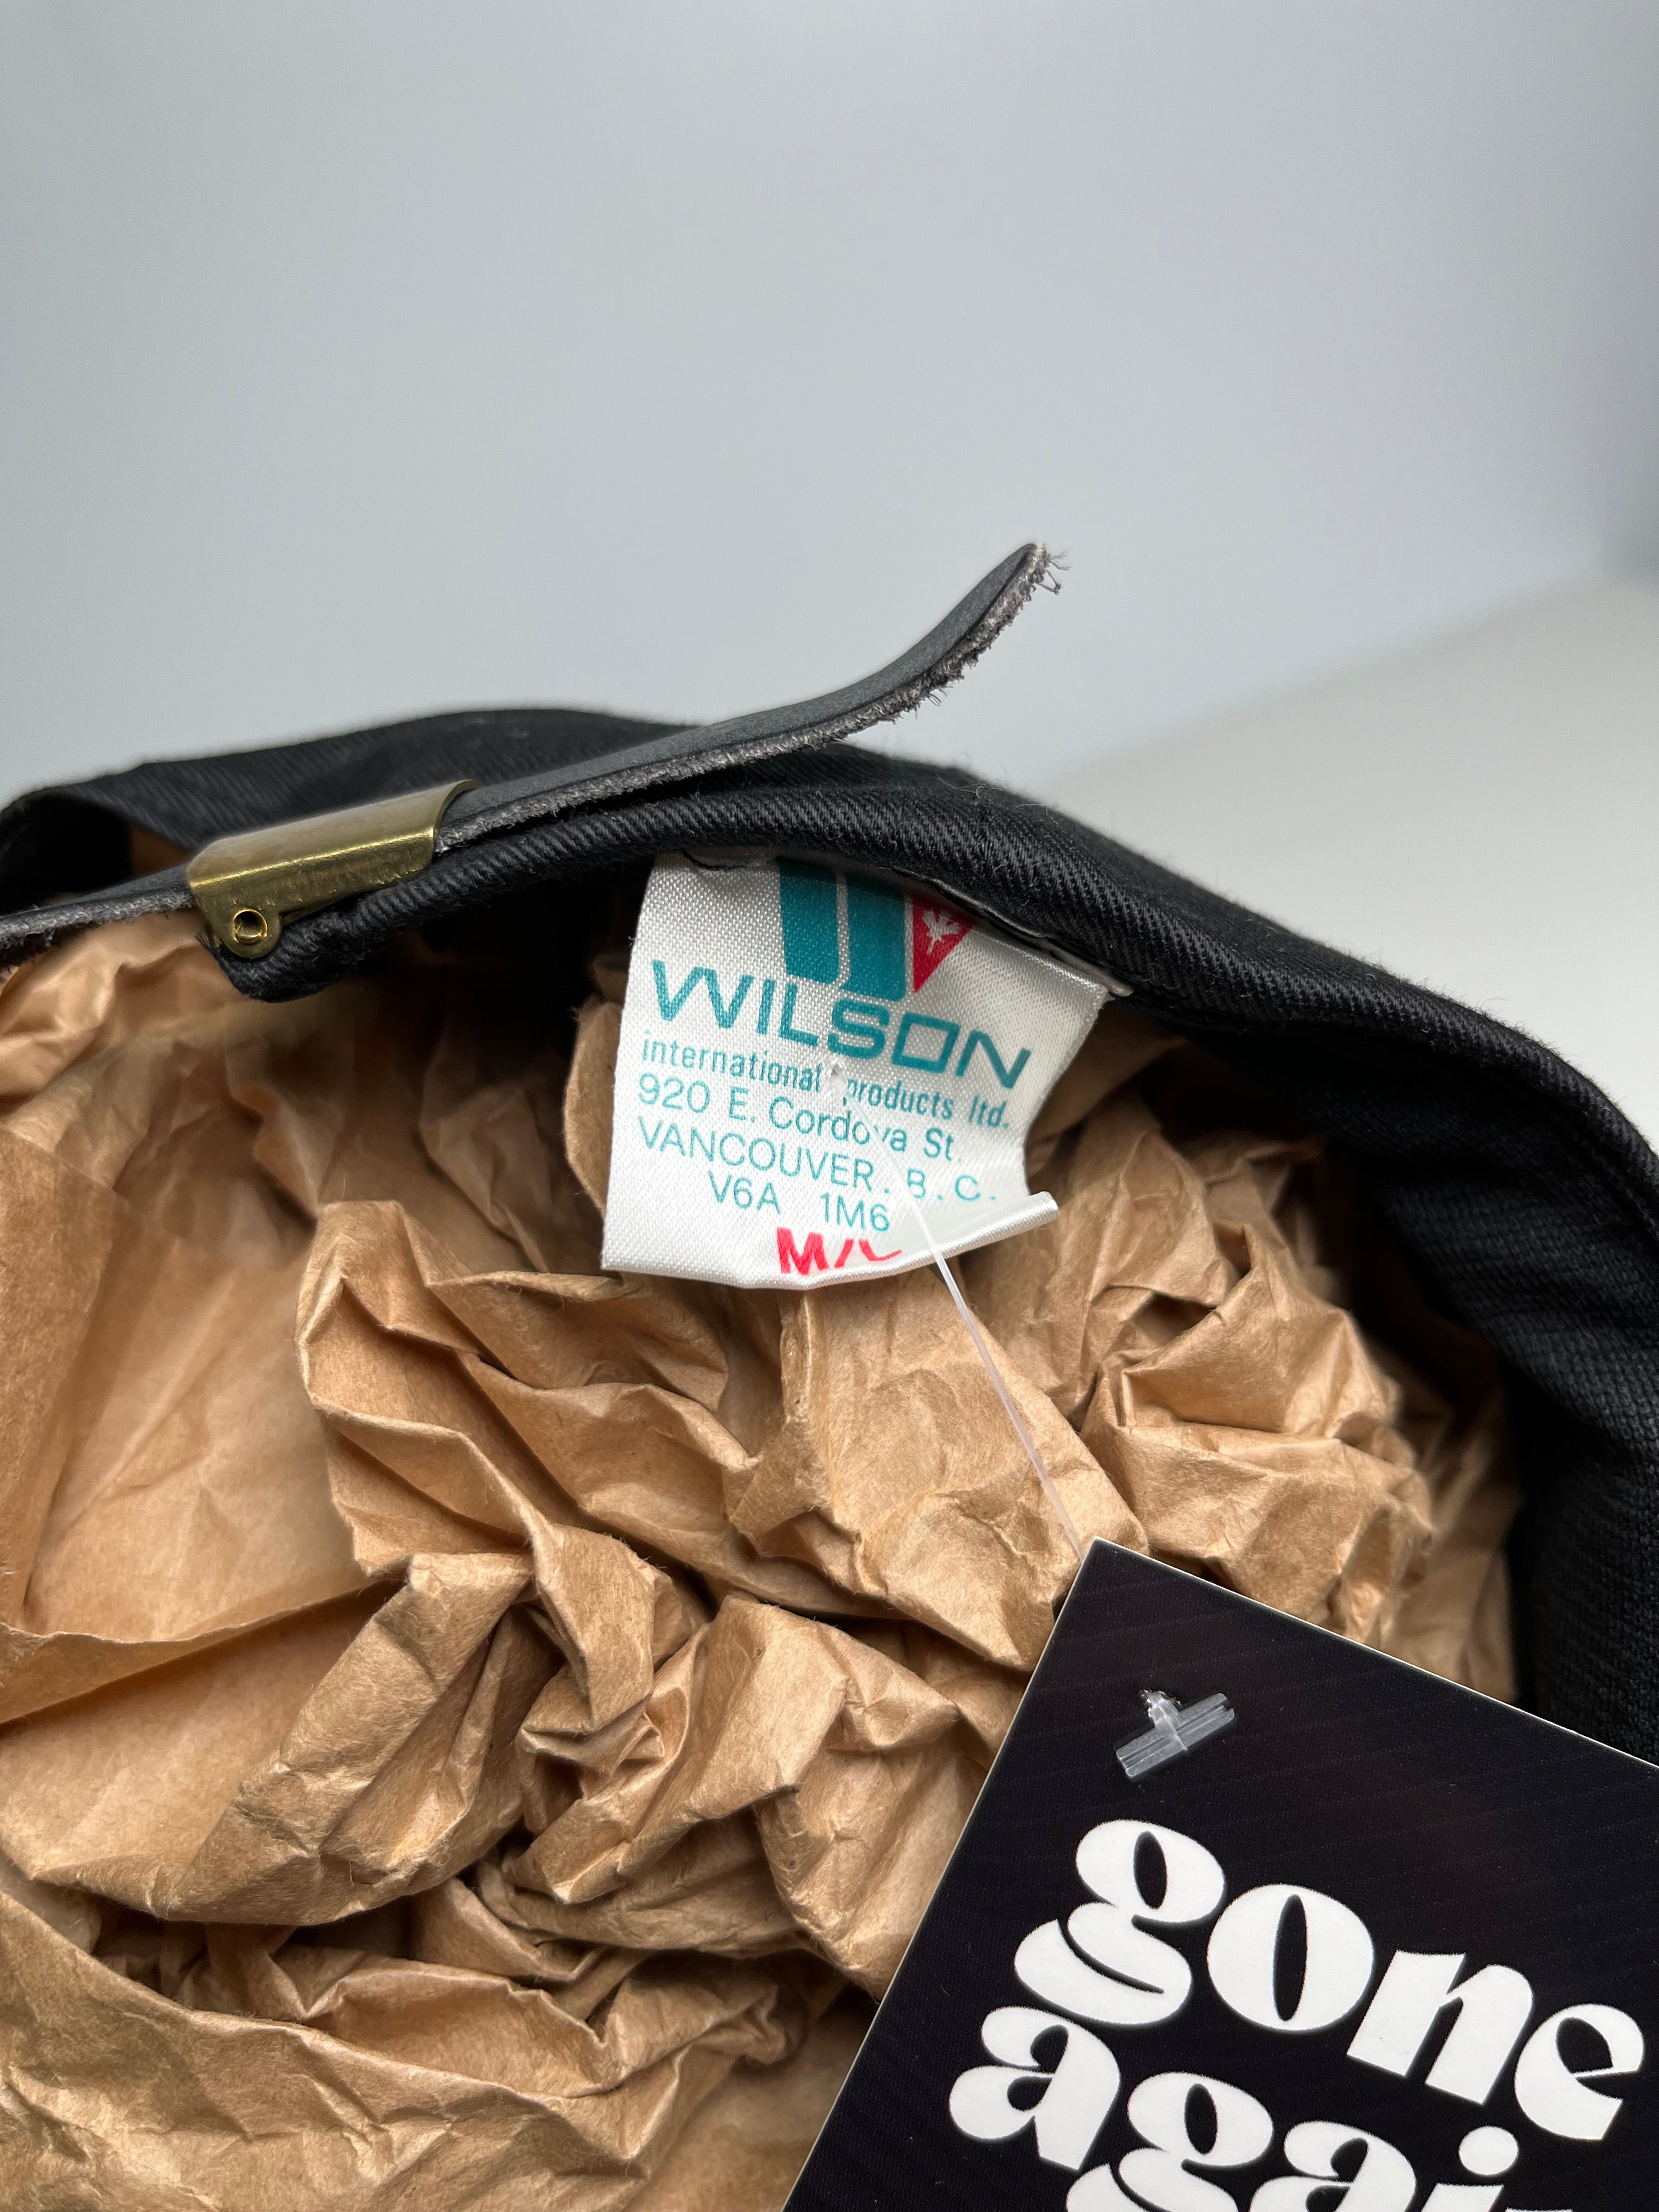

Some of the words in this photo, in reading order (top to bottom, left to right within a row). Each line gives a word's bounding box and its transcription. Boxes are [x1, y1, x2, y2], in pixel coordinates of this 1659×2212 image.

[650, 959, 1031, 1090] WILSON
[638, 1073, 711, 1114] 920
[728, 1086, 755, 1122] E.
[923, 1126, 962, 1163] St.
[642, 1029, 822, 1093] international
[968, 1094, 1009, 1130] ltd.
[708, 1170, 782, 1215] V6A
[820, 1192, 891, 1233] 1M6
[1014, 1819, 1645, 2141] gone
